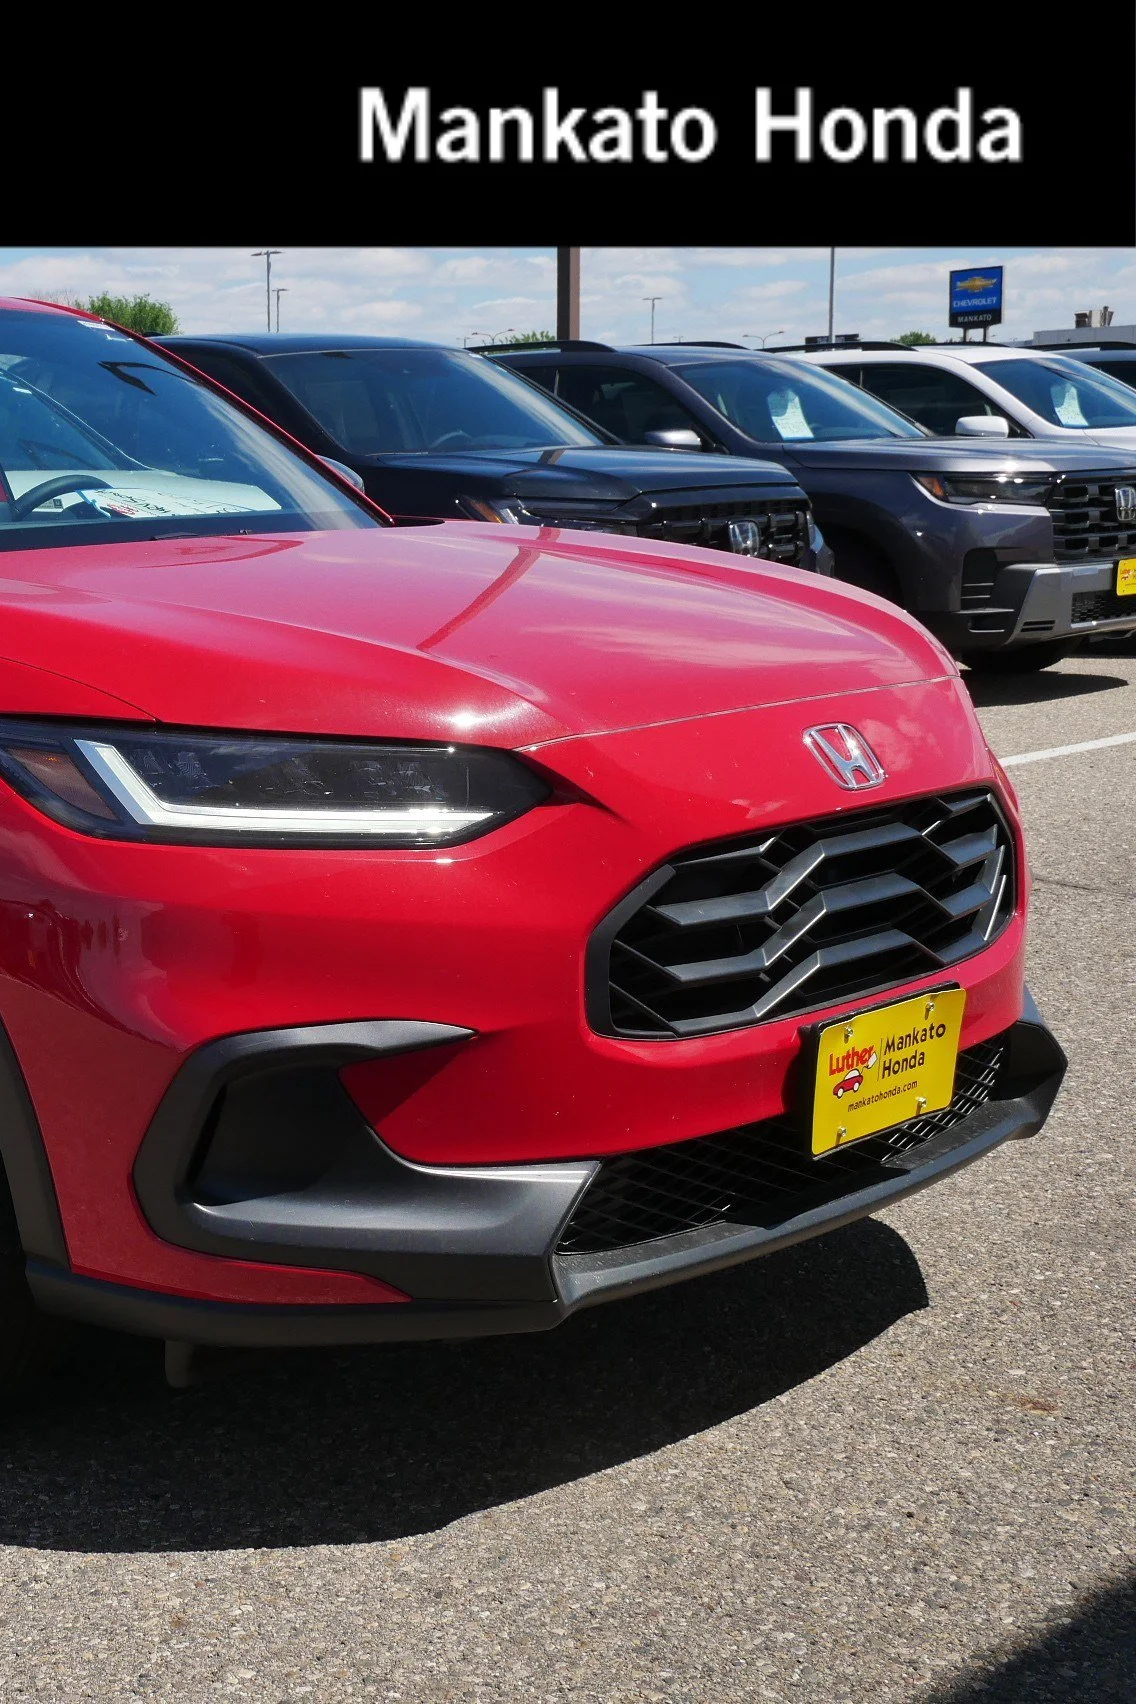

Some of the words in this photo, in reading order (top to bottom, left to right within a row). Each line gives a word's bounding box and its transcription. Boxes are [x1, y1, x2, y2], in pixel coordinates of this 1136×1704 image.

[953, 297, 997, 308] CHEVROLET
[958, 314, 992, 323] MANKATO
[883, 1022, 946, 1056] Mankato
[829, 1044, 875, 1077] Luther
[882, 1050, 925, 1080] Honda
[847, 1079, 918, 1113] mankatohonda.com
